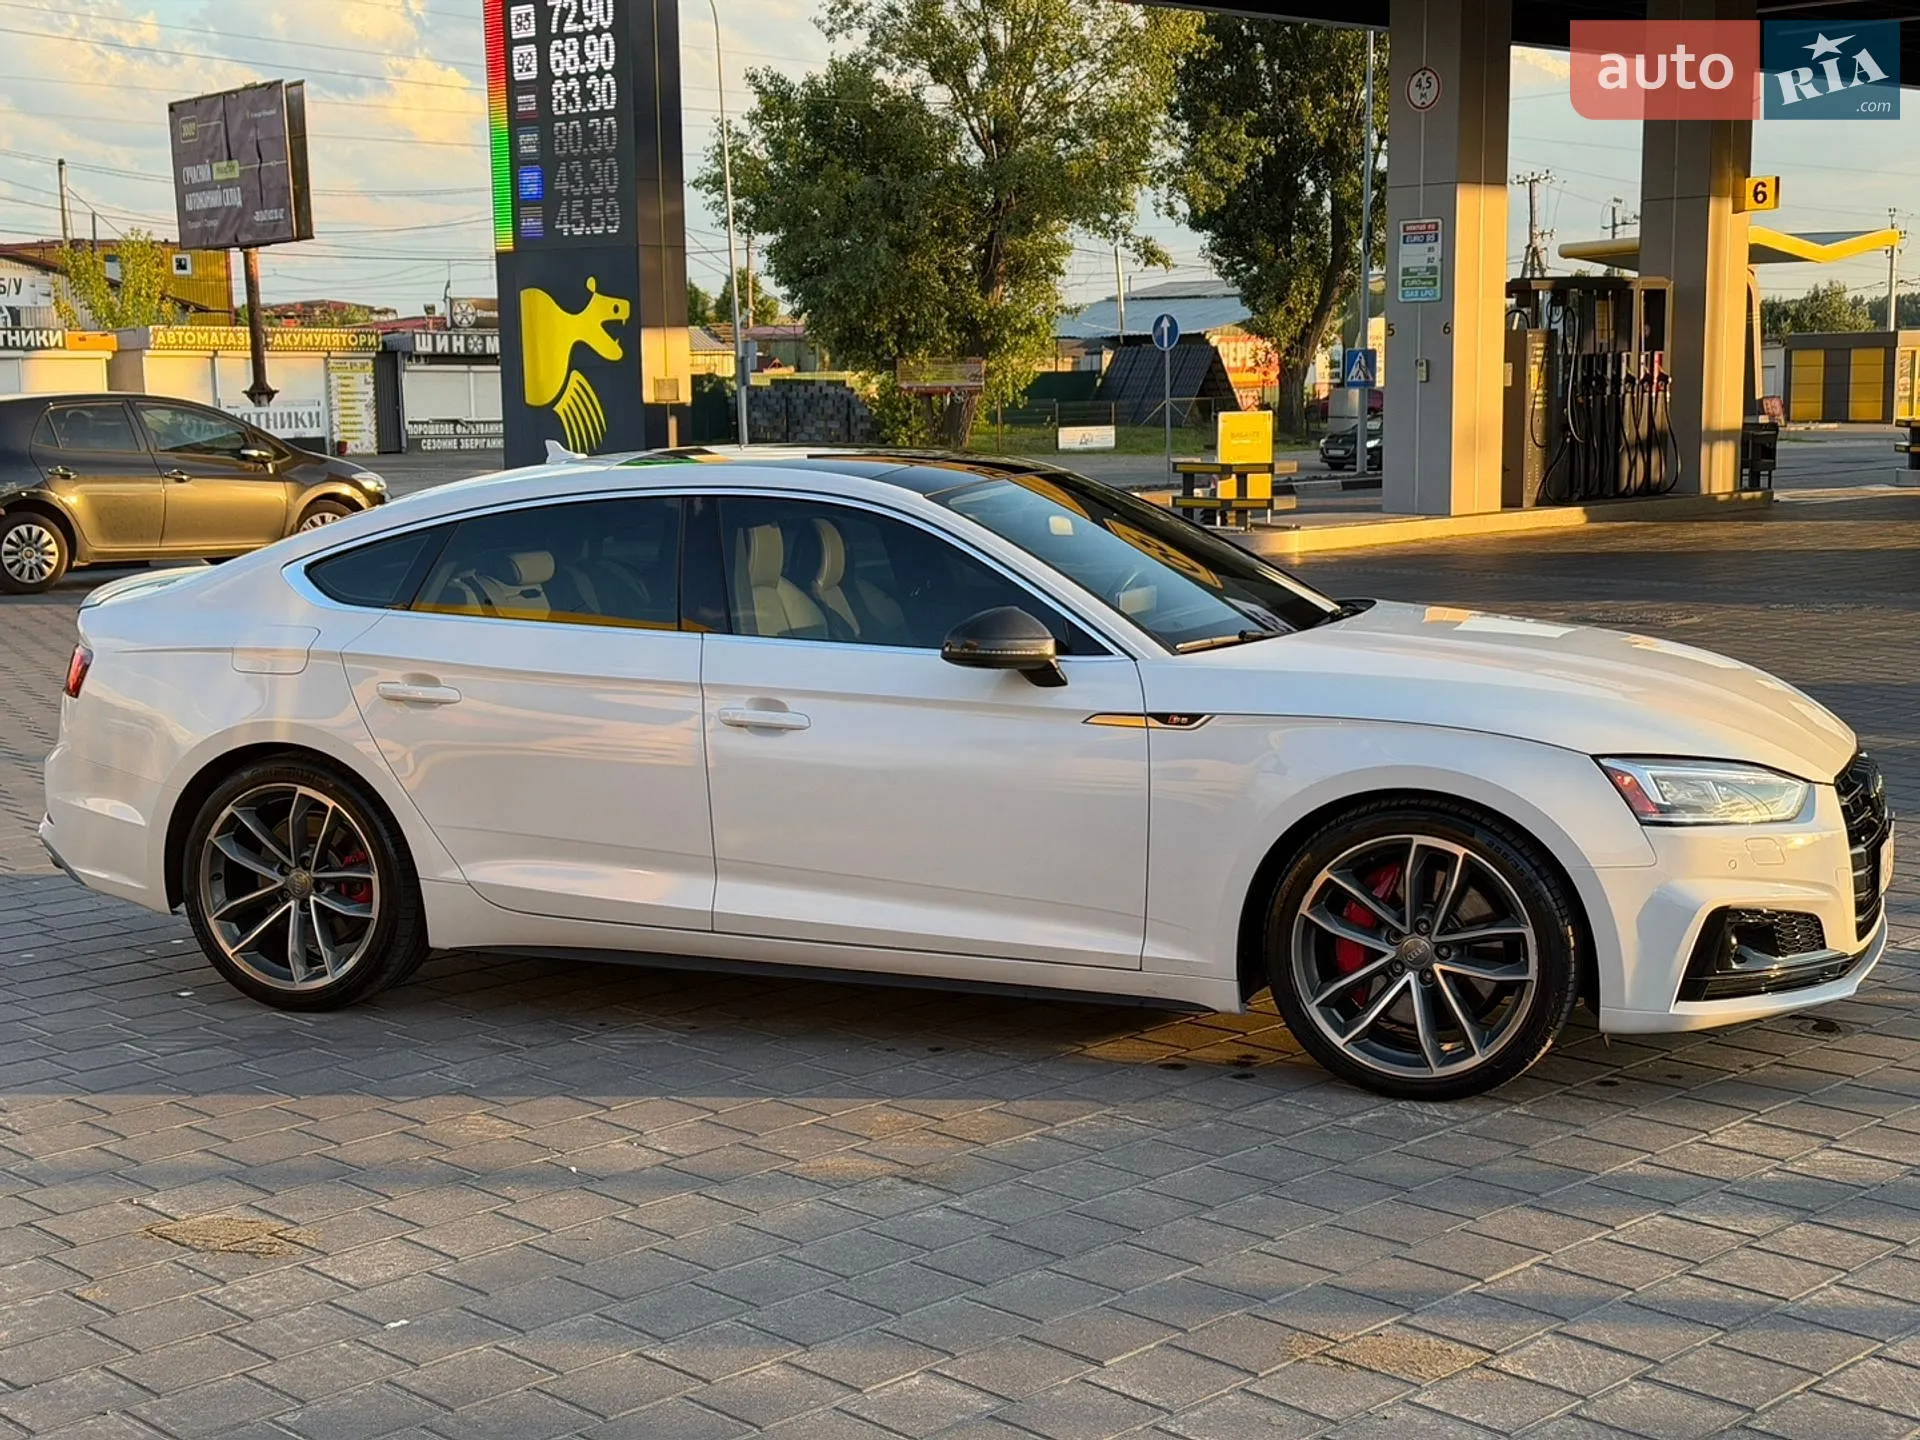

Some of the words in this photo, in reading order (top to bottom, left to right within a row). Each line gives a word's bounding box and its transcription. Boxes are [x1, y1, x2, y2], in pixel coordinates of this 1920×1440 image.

[515, 12, 531, 31] 95
[547, 0, 614, 33] 72.90
[517, 52, 533, 72] 92
[549, 33, 616, 77] 68.90
[551, 73, 617, 115] 83.30
[553, 117, 618, 157] 80.30
[1752, 181, 1768, 205] 6
[554, 197, 620, 236] 45.59
[155, 330, 377, 347] АВТОМАГАЗ-АКУМУЛЯТОРИ
[1387, 323, 1395, 337] 5
[1443, 322, 1451, 335] 6
[234, 411, 320, 429] ЯТНИКИ
